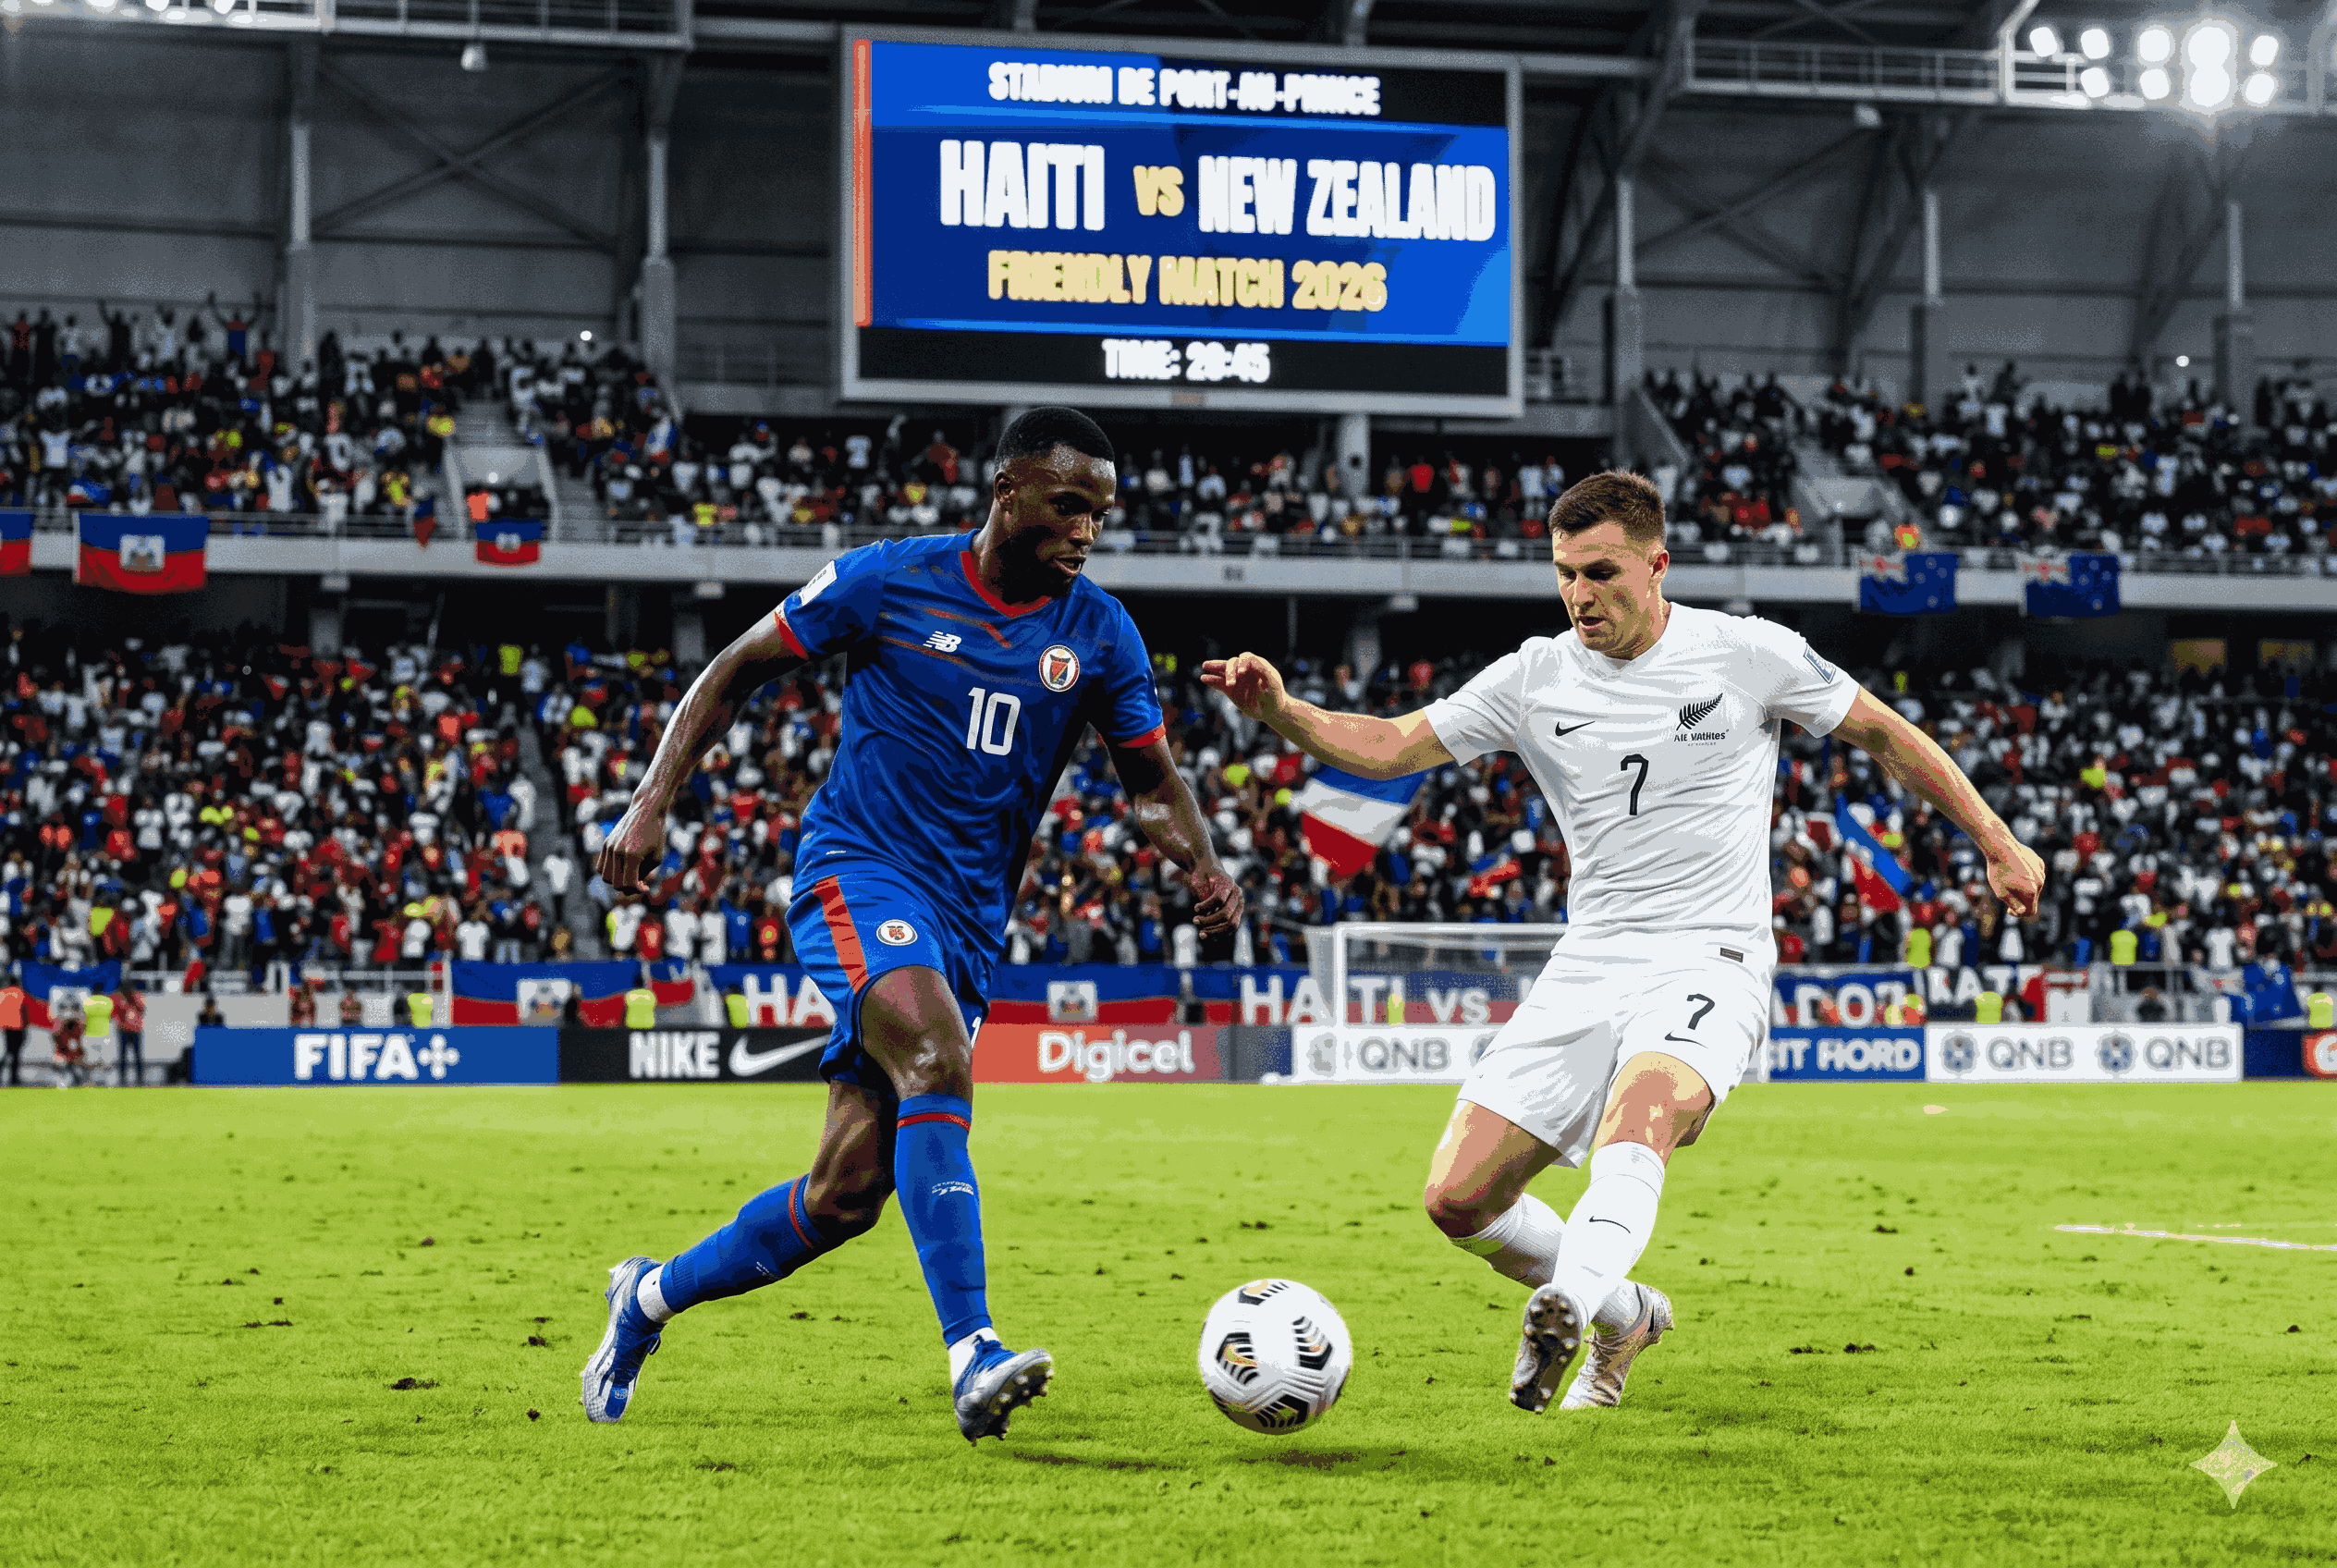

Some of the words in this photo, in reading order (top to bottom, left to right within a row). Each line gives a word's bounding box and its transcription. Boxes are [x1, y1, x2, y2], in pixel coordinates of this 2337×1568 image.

[940, 140, 1105, 230] HAITI
[1132, 165, 1184, 216] VS
[1198, 154, 1298, 235] NEW
[1306, 159, 1497, 241] ZEALAND
[988, 250, 1153, 304] FRIENDLY
[1158, 255, 1285, 309] MATCH
[1291, 260, 1388, 312] 2026
[966, 686, 1022, 756] 10
[1621, 753, 1649, 816] 7
[1686, 993, 1716, 1031] 7
[629, 1031, 721, 1079] NIKE
[1038, 1029, 1196, 1084] Digicel
[1357, 1036, 1453, 1074] QNB
[1986, 1035, 2074, 1072] QNB
[2143, 1035, 2233, 1072] QNB
